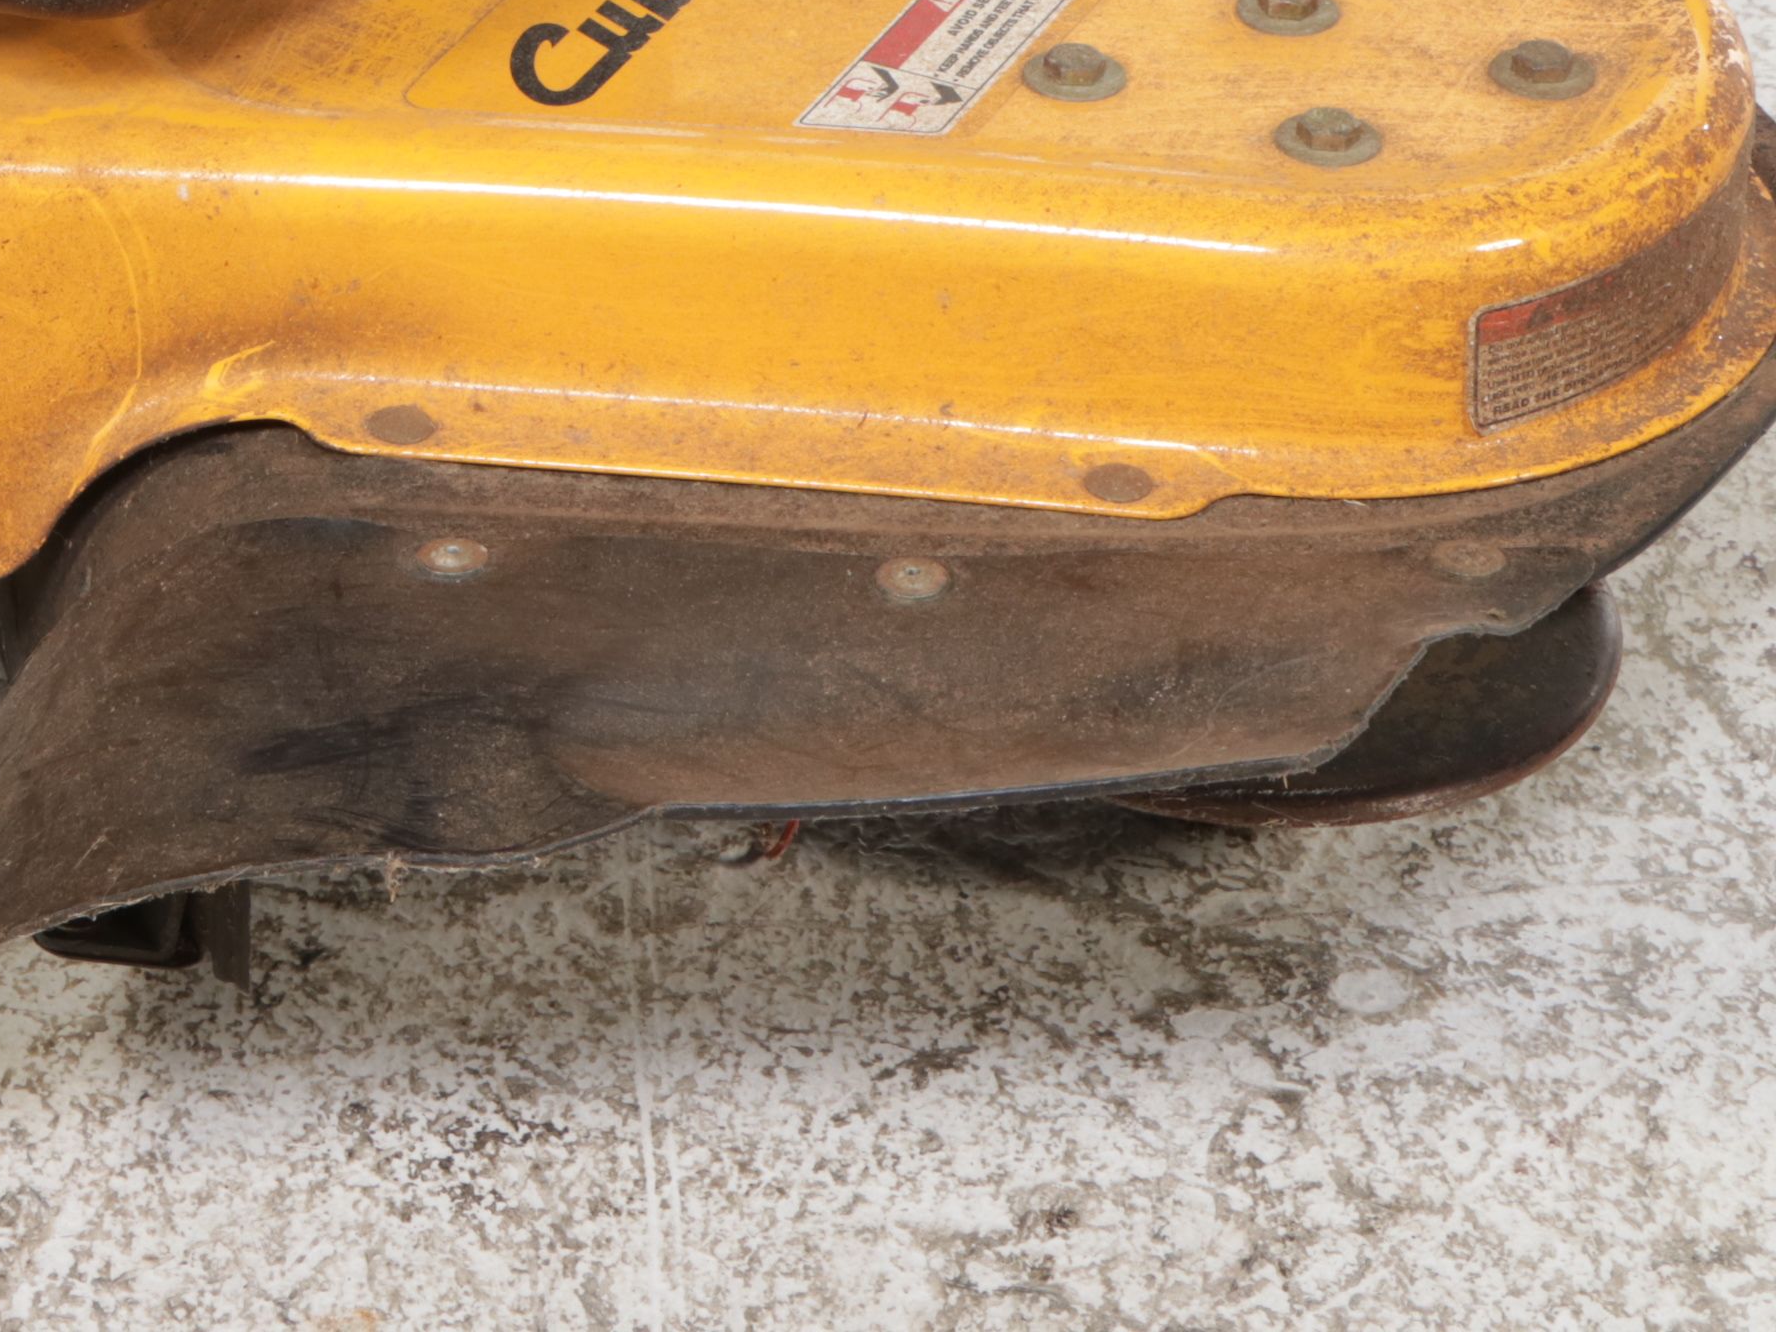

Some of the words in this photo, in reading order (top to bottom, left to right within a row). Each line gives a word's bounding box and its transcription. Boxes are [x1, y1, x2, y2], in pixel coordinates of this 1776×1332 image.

[939, 53, 962, 72] KEEP
[956, 28, 985, 53] HANDS
[980, 13, 999, 28] AND
[947, 9, 978, 36] AVOID
[957, 48, 991, 78] REMOVE
[984, 18, 1019, 49] OBJECTS
[1013, 0, 1036, 18] THAT
